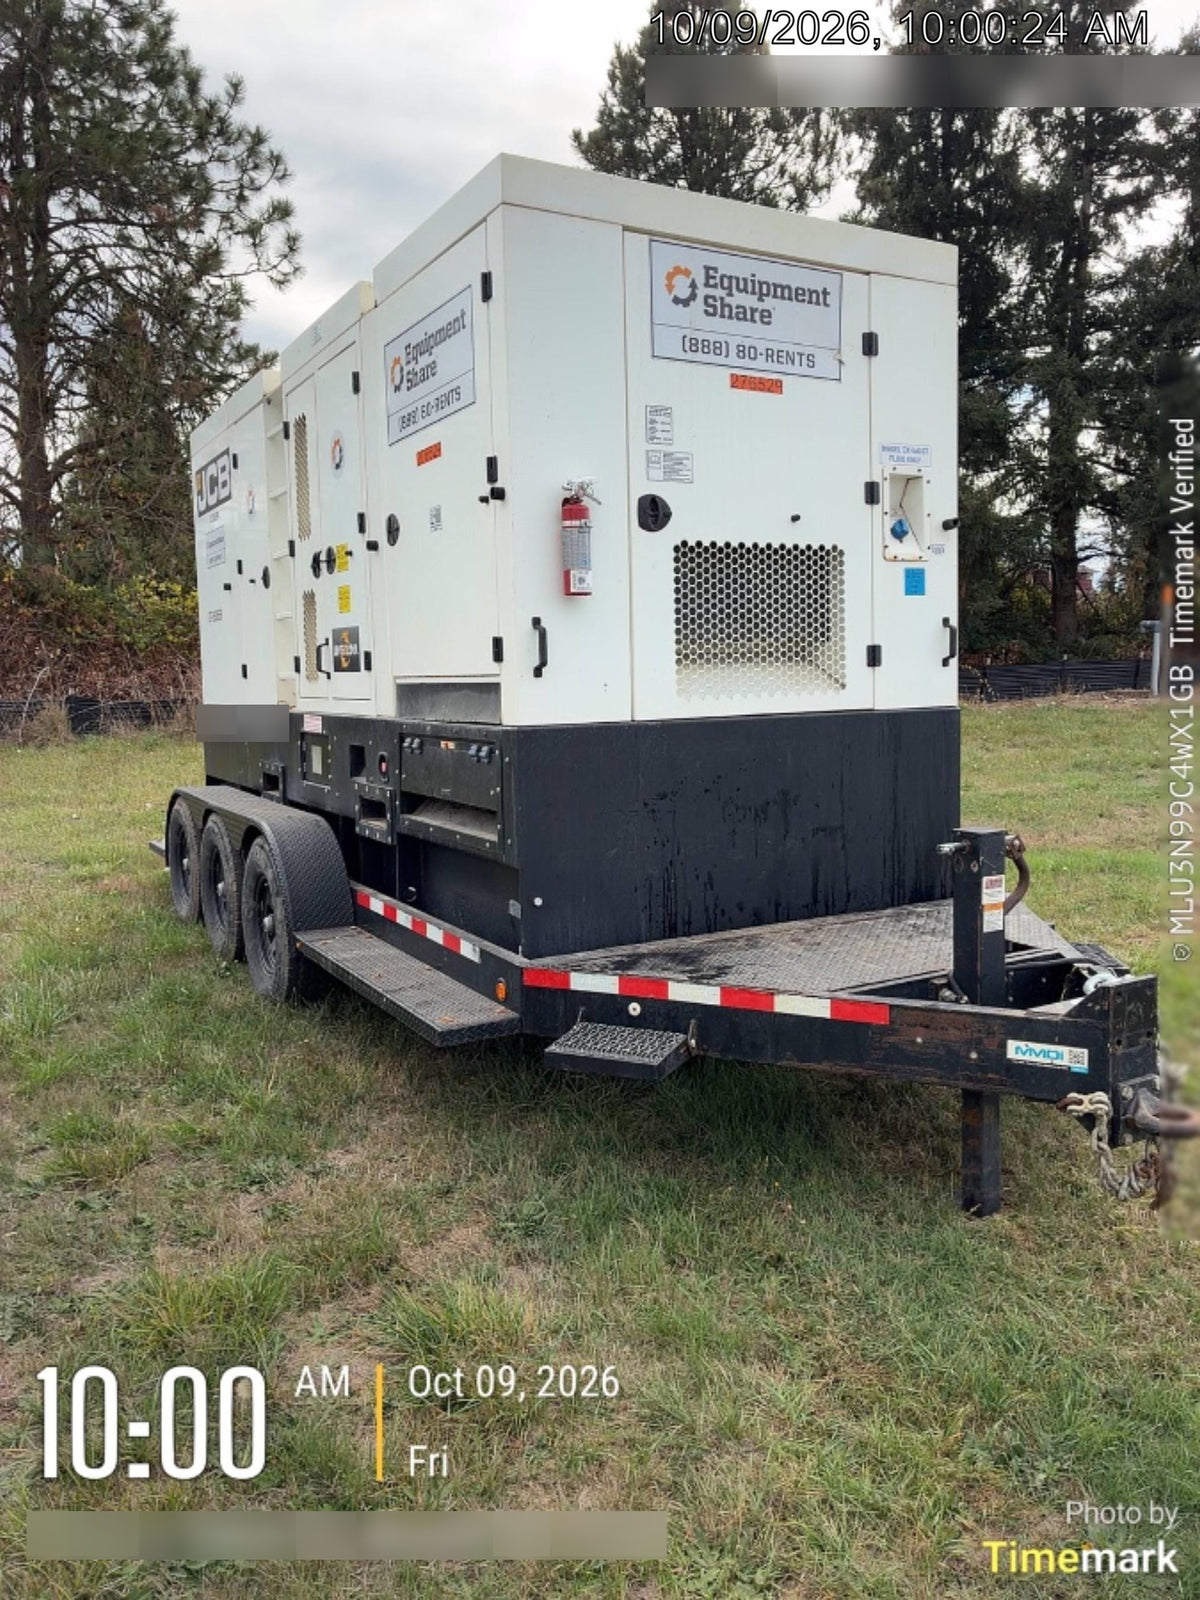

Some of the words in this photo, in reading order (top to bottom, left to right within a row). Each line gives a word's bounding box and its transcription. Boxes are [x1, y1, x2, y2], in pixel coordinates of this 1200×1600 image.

[703, 265, 831, 307] Equipment
[703, 294, 773, 326] Share
[404, 308, 467, 367] Equipment
[681, 334, 730, 359] (888)
[735, 343, 815, 369] 80-RENTS
[406, 359, 438, 392] Share
[196, 454, 231, 514] JCB
